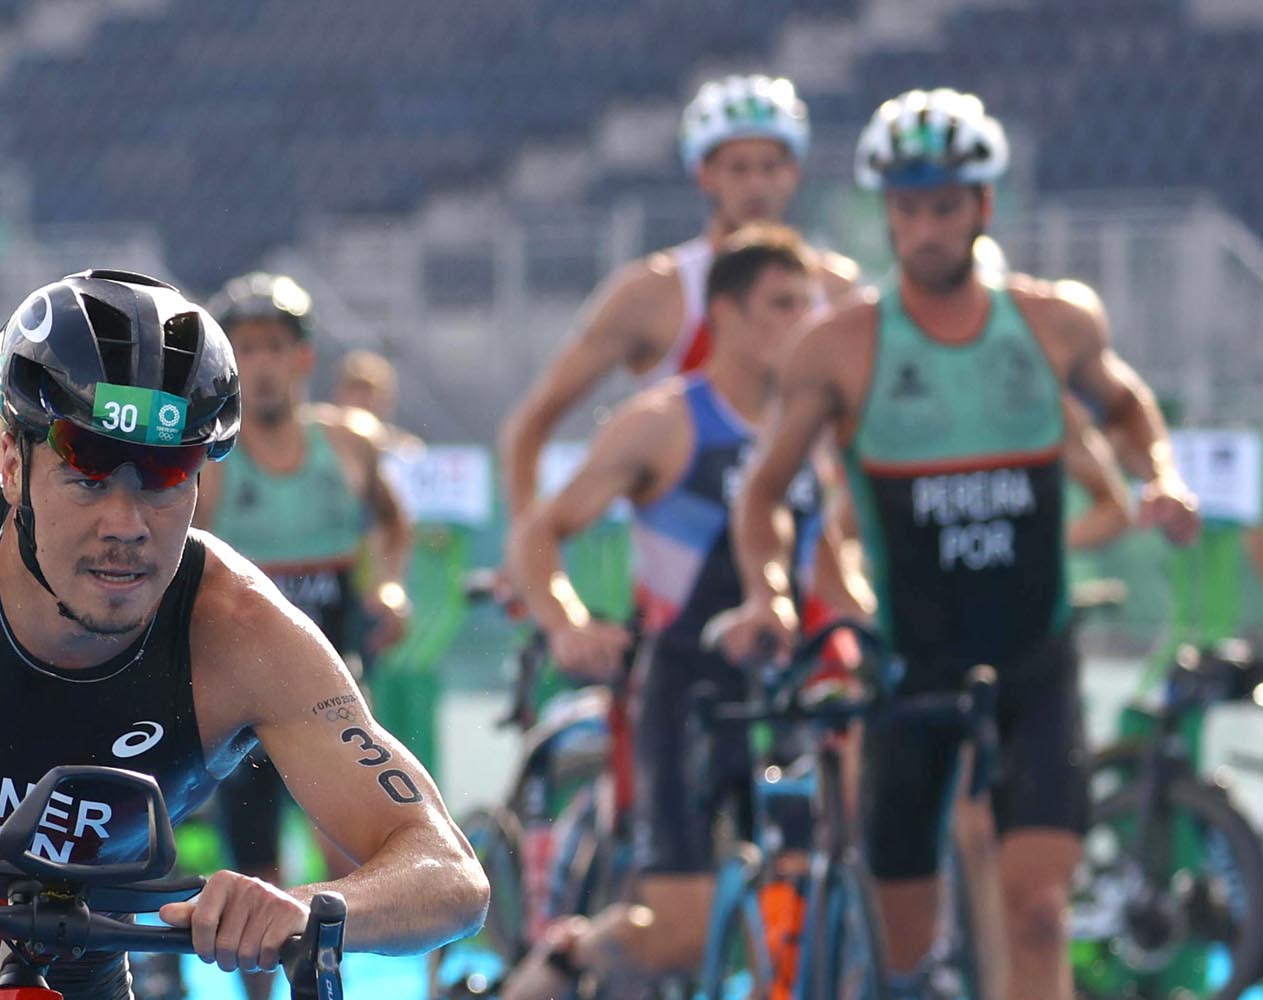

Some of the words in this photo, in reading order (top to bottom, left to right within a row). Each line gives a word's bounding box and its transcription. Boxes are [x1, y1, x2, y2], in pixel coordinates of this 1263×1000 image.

[102, 401, 138, 433] 30
[939, 520, 1016, 572] POR
[340, 726, 424, 804] 30
